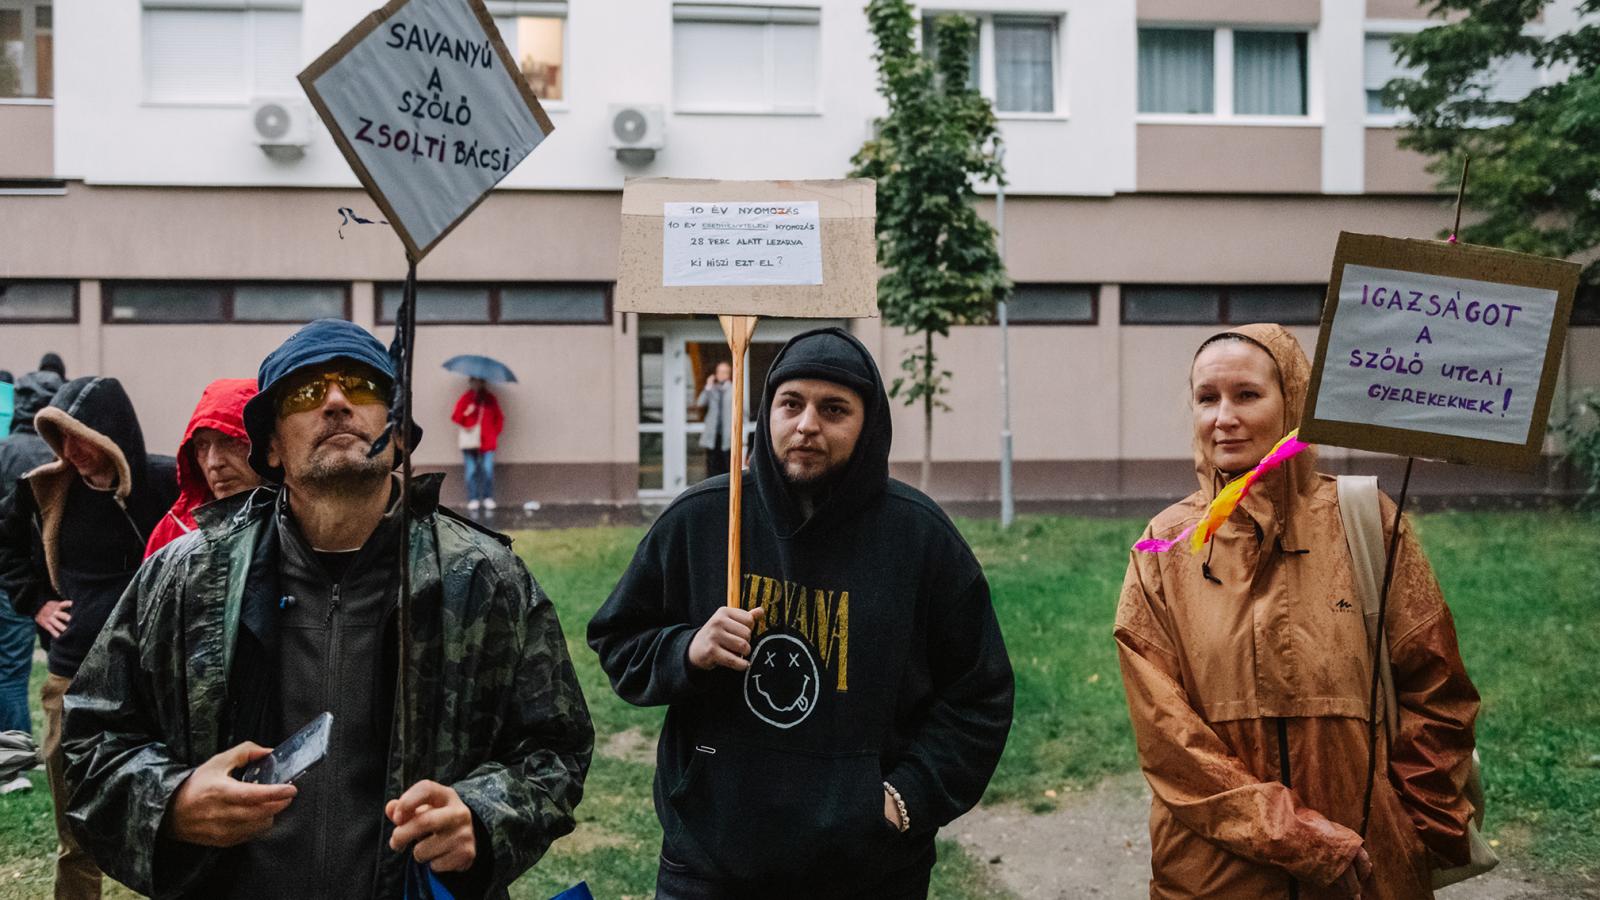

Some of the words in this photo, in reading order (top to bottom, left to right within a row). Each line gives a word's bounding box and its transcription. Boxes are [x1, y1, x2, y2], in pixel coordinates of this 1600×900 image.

[427, 67, 443, 92] A
[711, 205, 729, 214] ÉV
[738, 207, 799, 215] NYOMOZÁS
[668, 221, 680, 229] 10
[775, 223, 815, 231] NYOMOZÁS
[735, 259, 755, 267] EZT
[1361, 284, 1522, 327] IGAZSÁGOT
[1415, 326, 1432, 344] A
[741, 573, 849, 692] IRVANA
